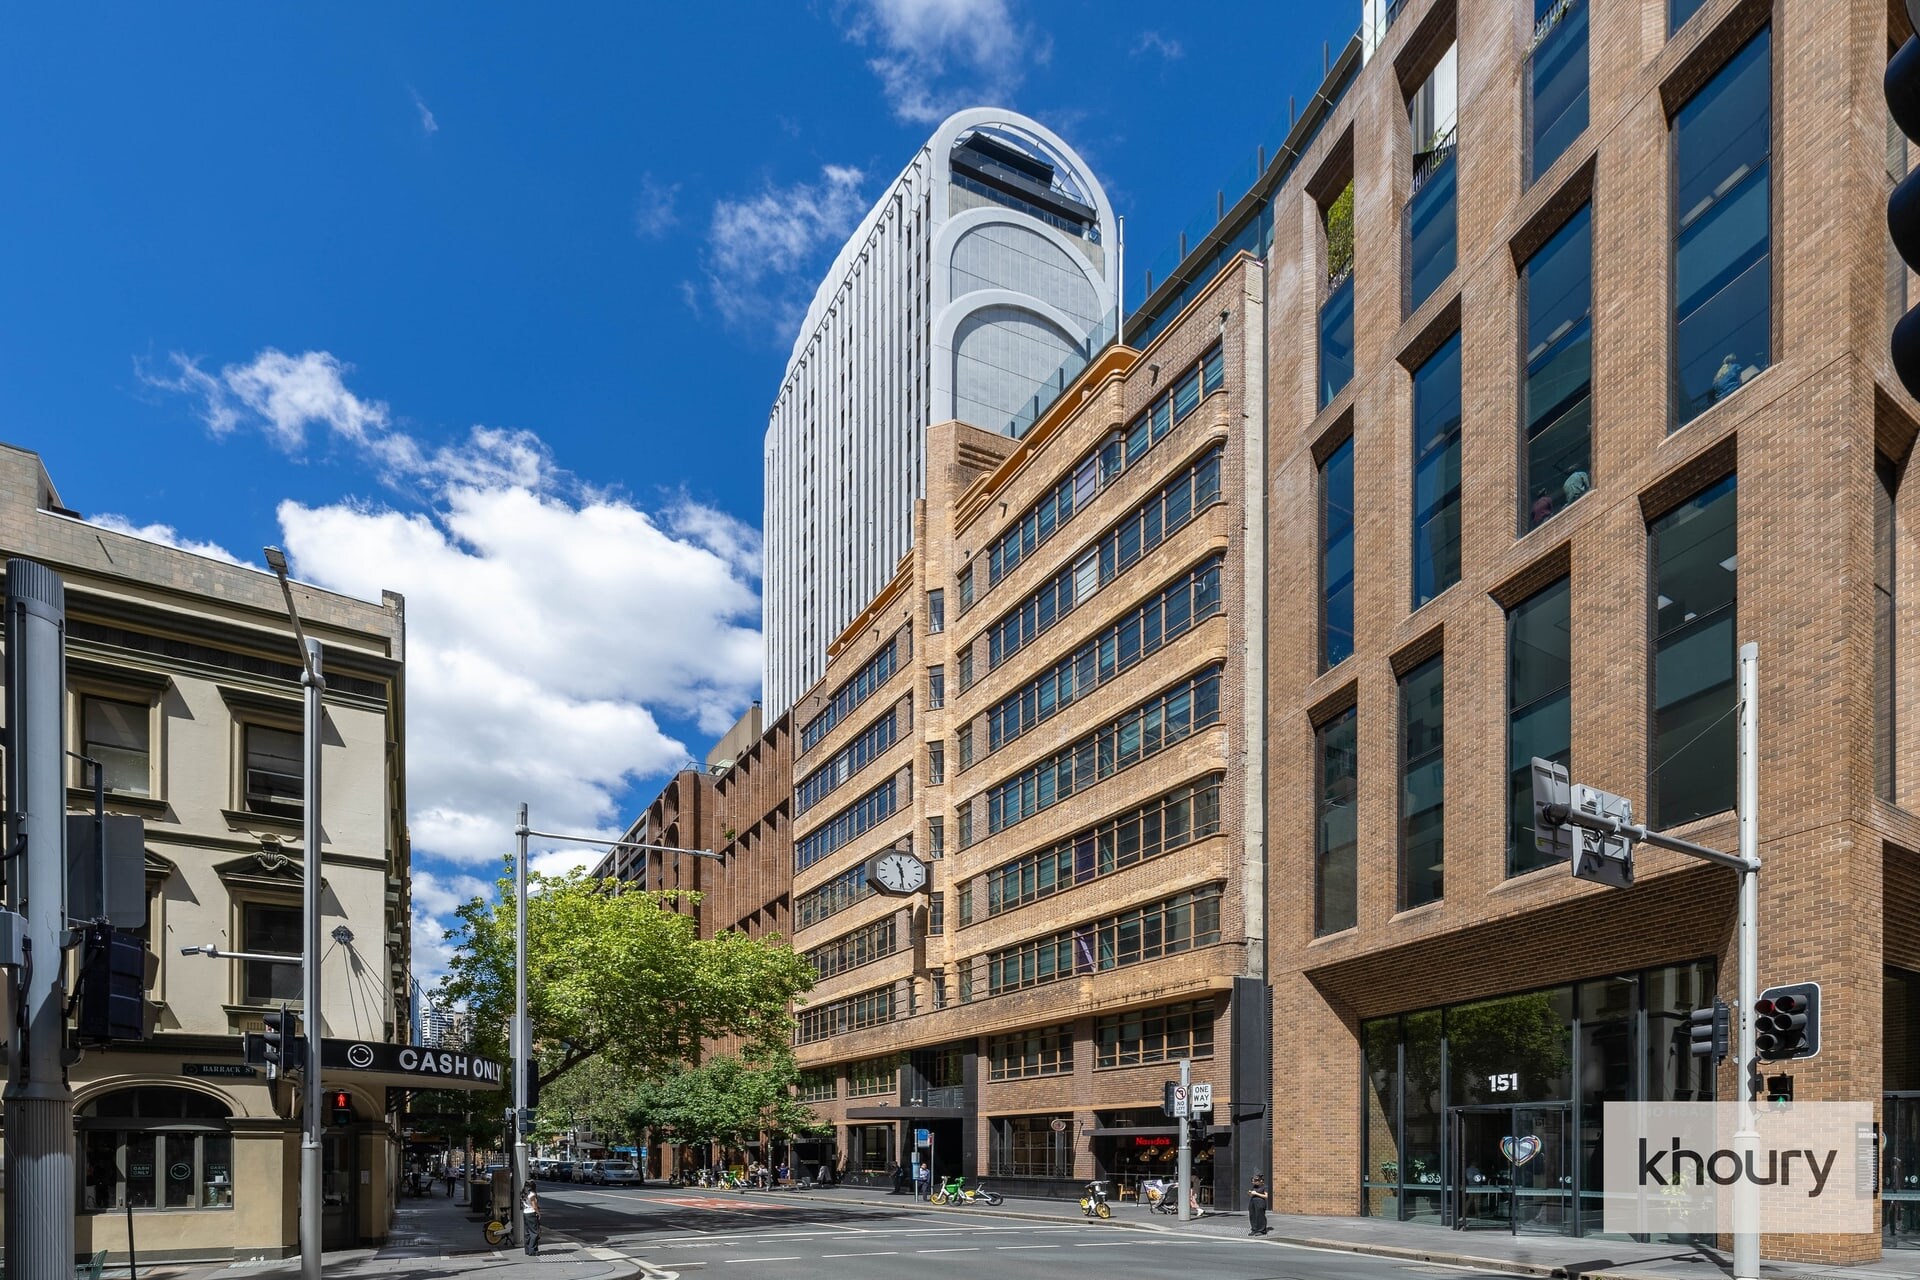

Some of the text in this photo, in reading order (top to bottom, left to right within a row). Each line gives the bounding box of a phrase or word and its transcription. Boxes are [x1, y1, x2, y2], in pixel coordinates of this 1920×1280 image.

[202, 1065, 241, 1073] BARRACK
[399, 1049, 501, 1082] CASH ONLY
[1488, 1073, 1518, 1092] 151
[1136, 1137, 1171, 1146] Nando's
